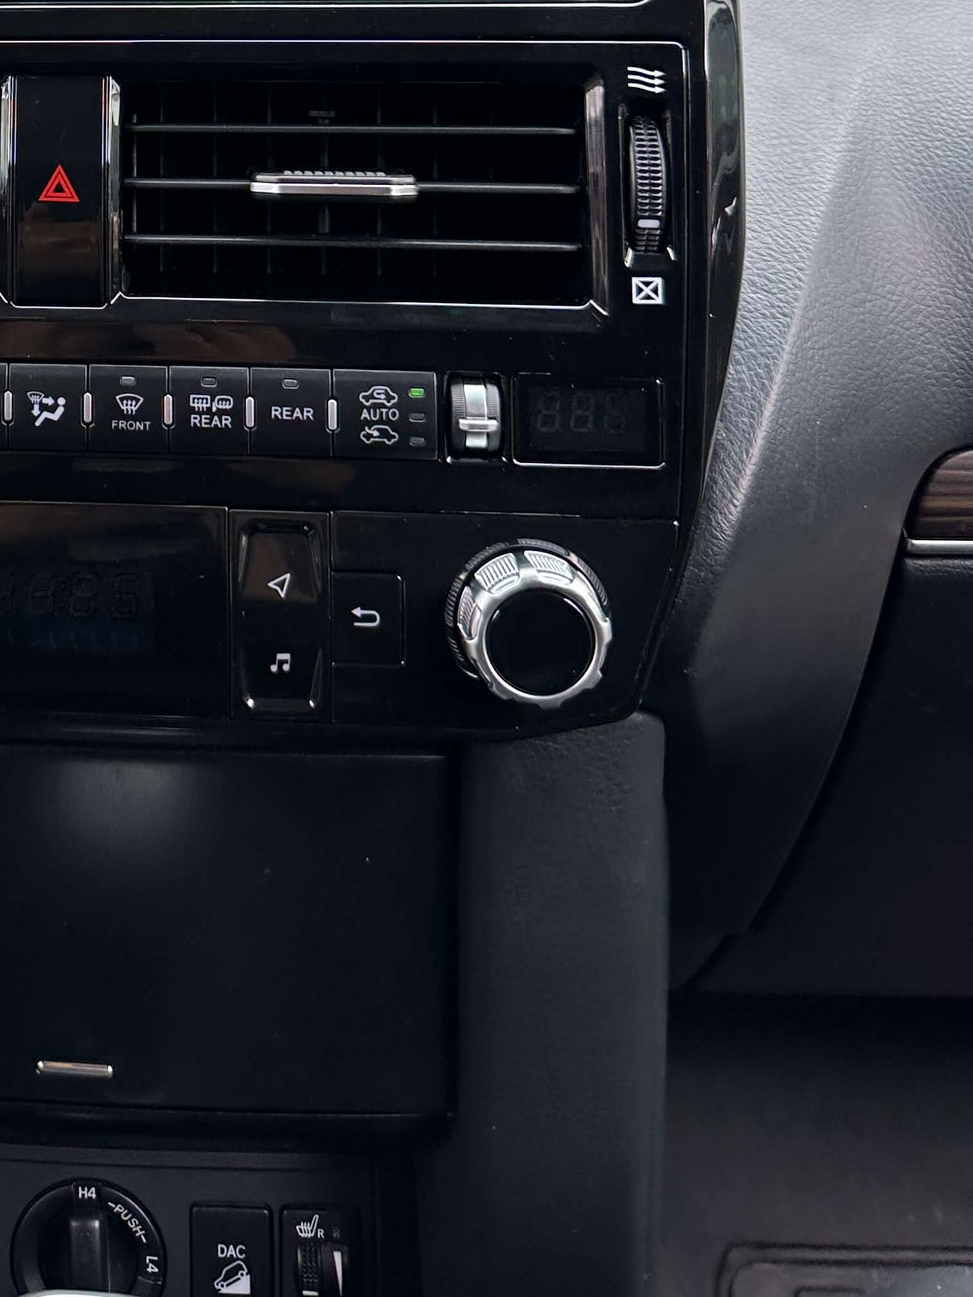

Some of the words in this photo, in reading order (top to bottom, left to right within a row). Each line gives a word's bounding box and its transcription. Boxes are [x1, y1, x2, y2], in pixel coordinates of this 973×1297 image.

[271, 406, 314, 421] REAR
[360, 408, 400, 422] AUTO
[111, 420, 151, 431] FRONT
[190, 414, 232, 429] REAR
[78, 1186, 97, 1199] H4
[317, 1228, 325, 1239] R
[217, 1244, 246, 1259] DAC
[146, 1256, 159, 1274] L4
